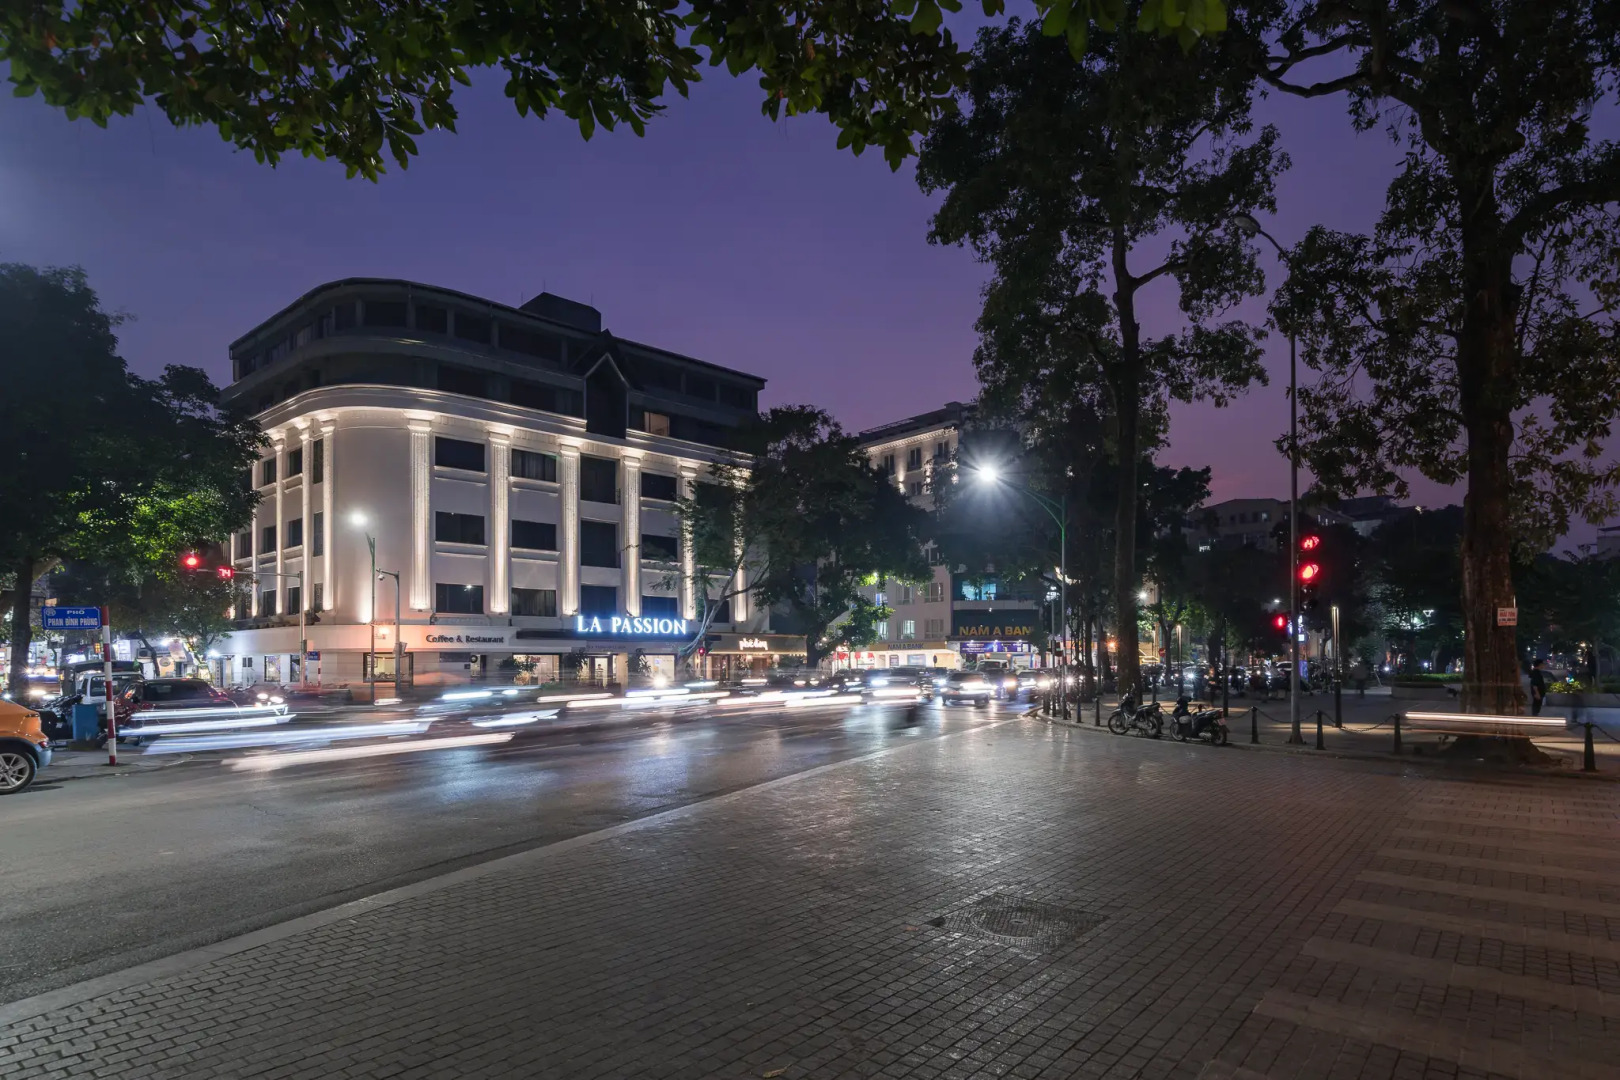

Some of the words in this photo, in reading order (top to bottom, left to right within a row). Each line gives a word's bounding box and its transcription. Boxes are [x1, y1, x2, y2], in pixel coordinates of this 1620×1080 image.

[48, 618, 64, 627] PHAN
[80, 616, 98, 626] PHÙNG
[577, 615, 602, 633] LA
[611, 616, 687, 635] PASSION
[959, 626, 990, 636] NAM
[993, 626, 1002, 636] A
[1005, 626, 1033, 636] BAN
[426, 634, 454, 643] Coffee
[456, 635, 463, 643] &
[465, 635, 504, 644] Restaurant
